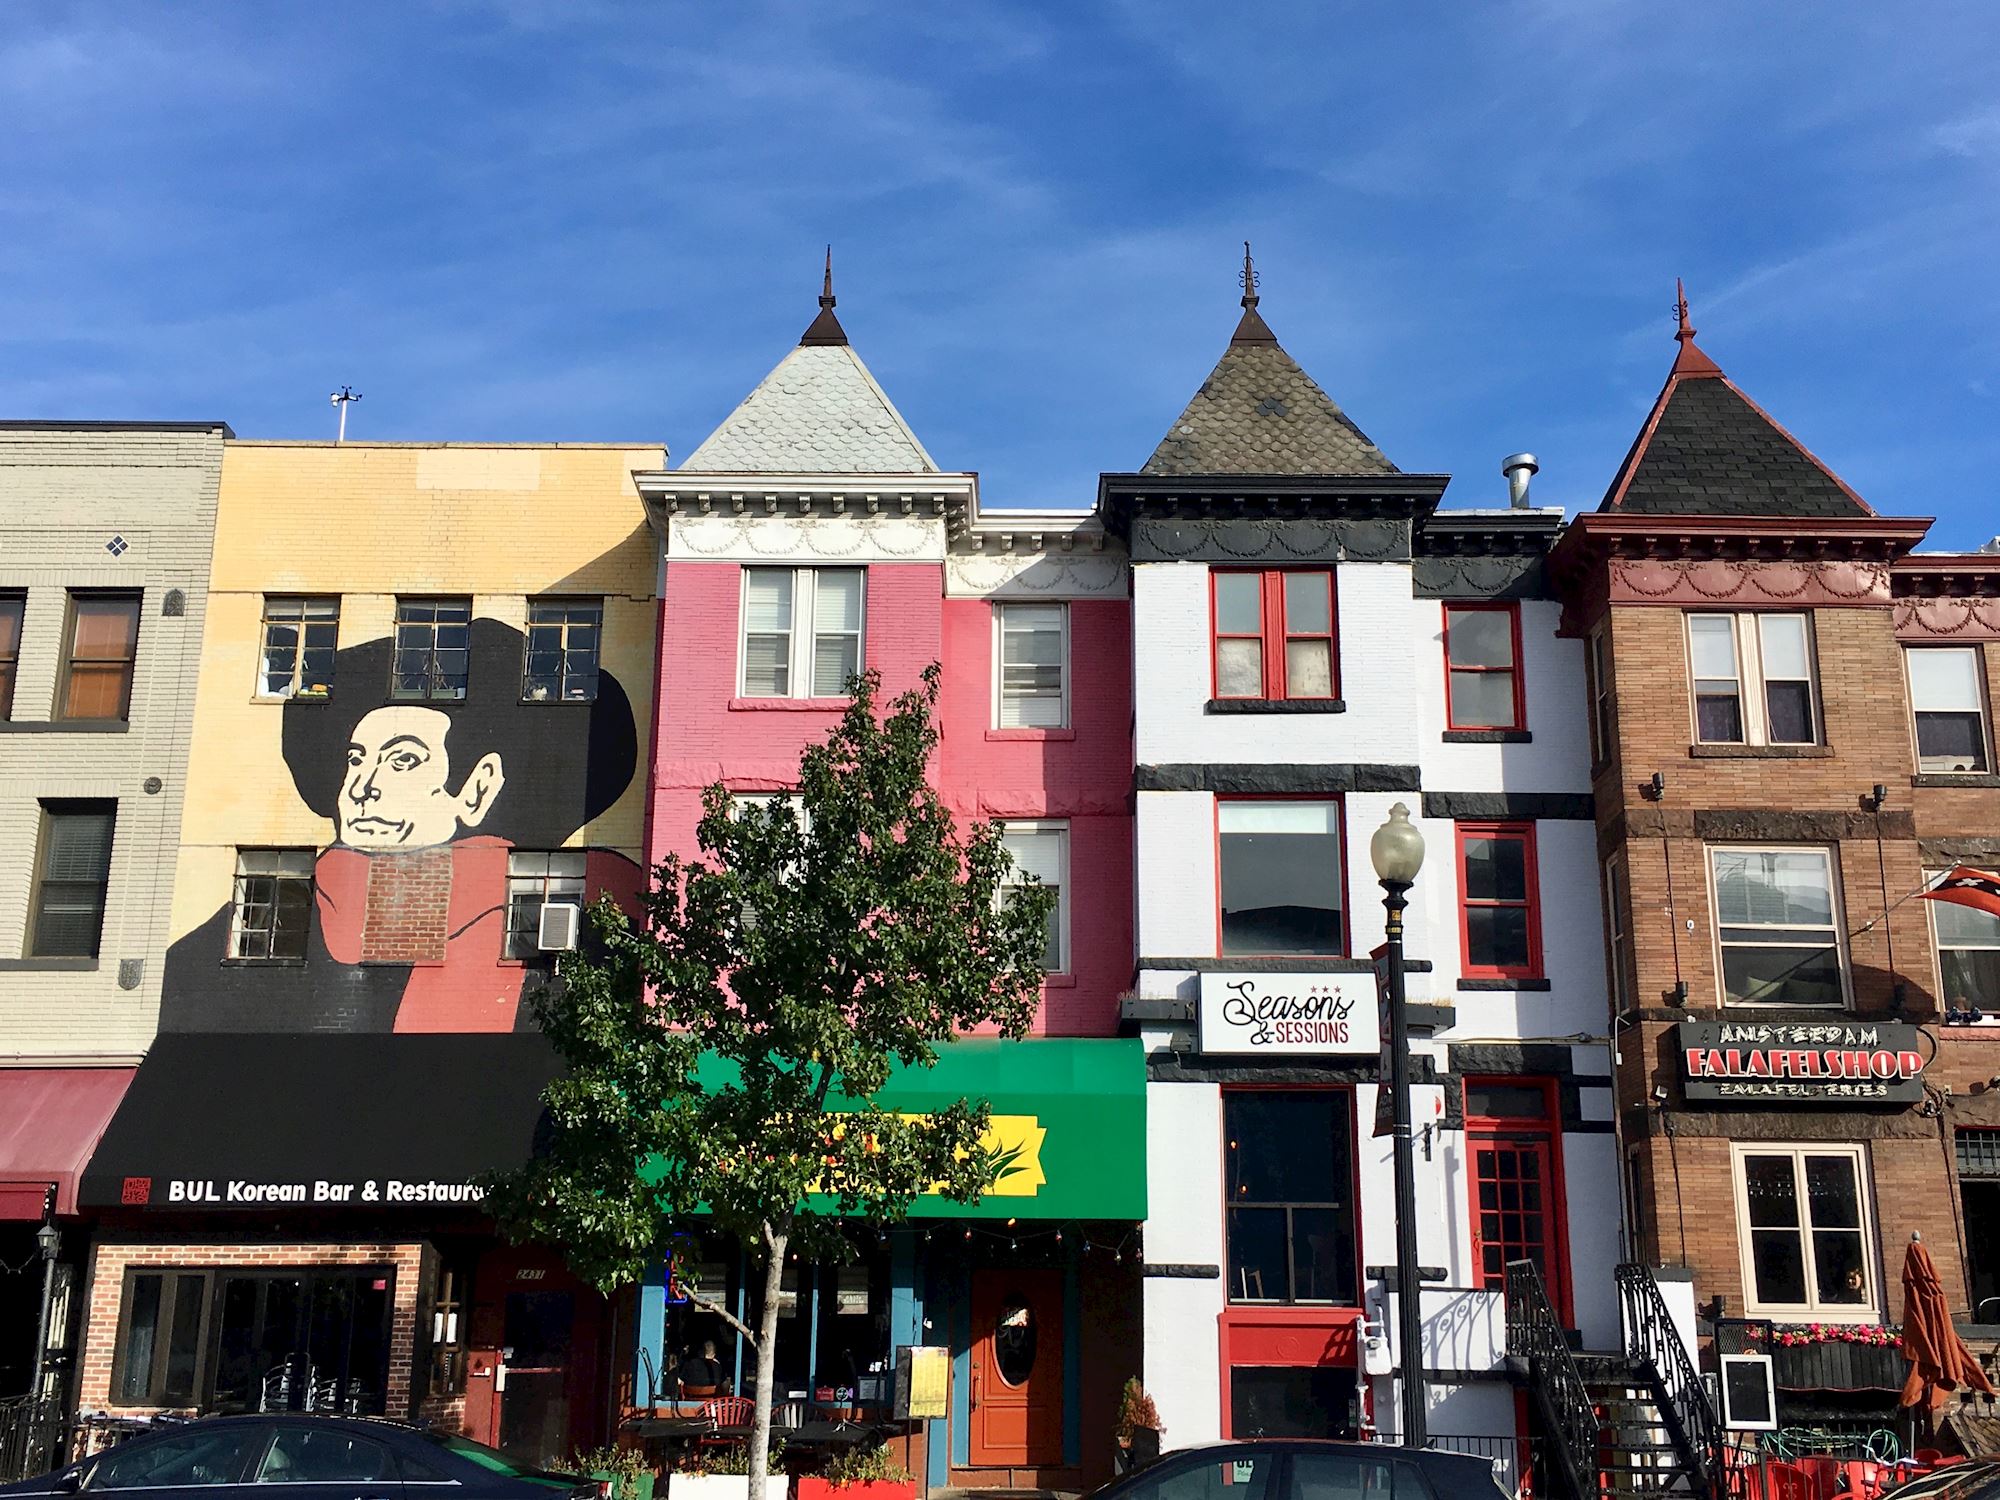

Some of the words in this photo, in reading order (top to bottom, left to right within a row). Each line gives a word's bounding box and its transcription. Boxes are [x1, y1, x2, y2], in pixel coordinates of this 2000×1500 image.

[1223, 980, 1355, 1026] Seasons
[1250, 1021, 1274, 1045] &
[1276, 1022, 1349, 1044] SESSIONS
[1719, 1022, 1878, 1047] AMSTERDAM
[168, 1180, 221, 1202] BUL
[227, 1180, 307, 1202] Korean
[313, 1180, 355, 1202] Bar
[361, 1179, 380, 1202] &
